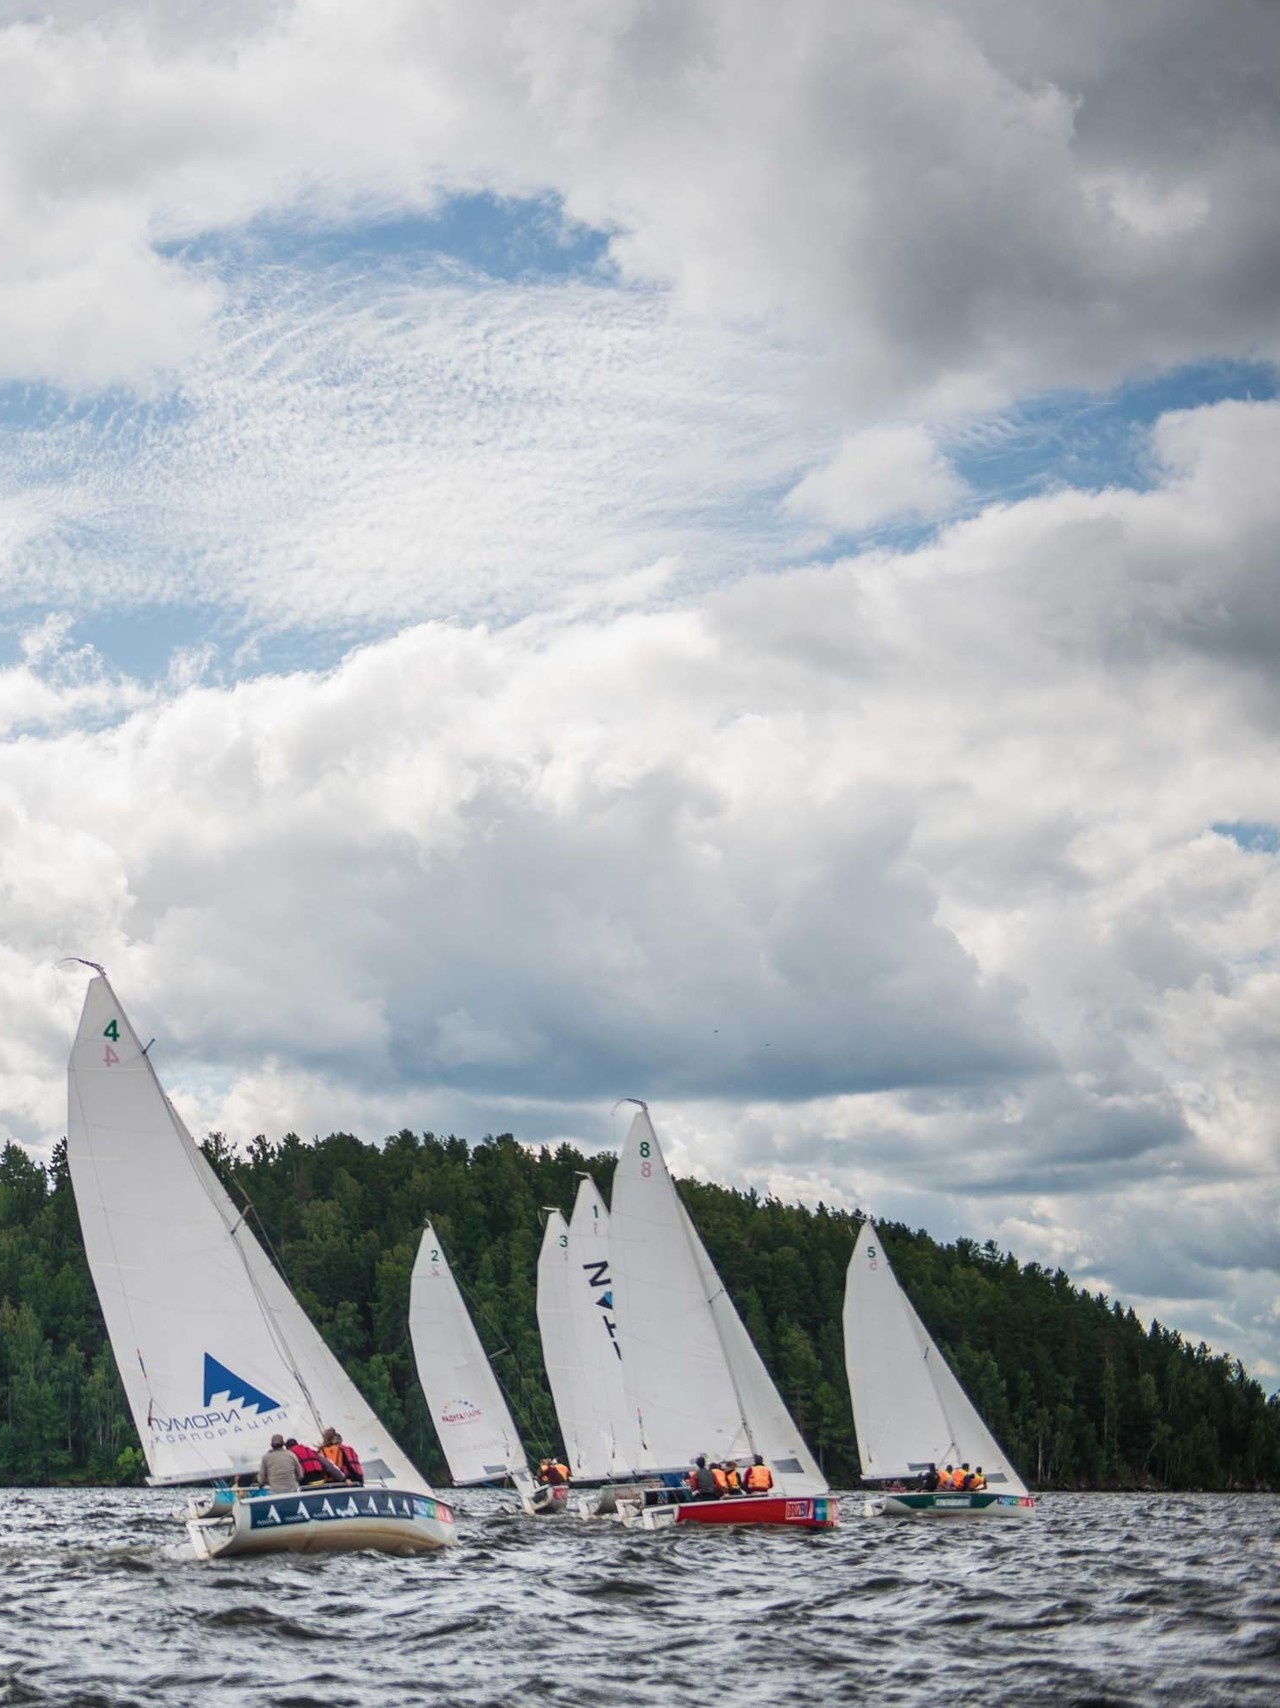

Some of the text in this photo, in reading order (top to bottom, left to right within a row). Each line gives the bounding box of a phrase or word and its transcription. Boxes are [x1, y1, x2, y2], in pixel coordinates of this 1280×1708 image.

[103, 1019, 120, 1042] 4
[640, 1141, 650, 1158] 8
[593, 1204, 598, 1219] 1
[559, 1235, 568, 1248] 3
[431, 1249, 440, 1262] 2
[867, 1246, 876, 1258] 5
